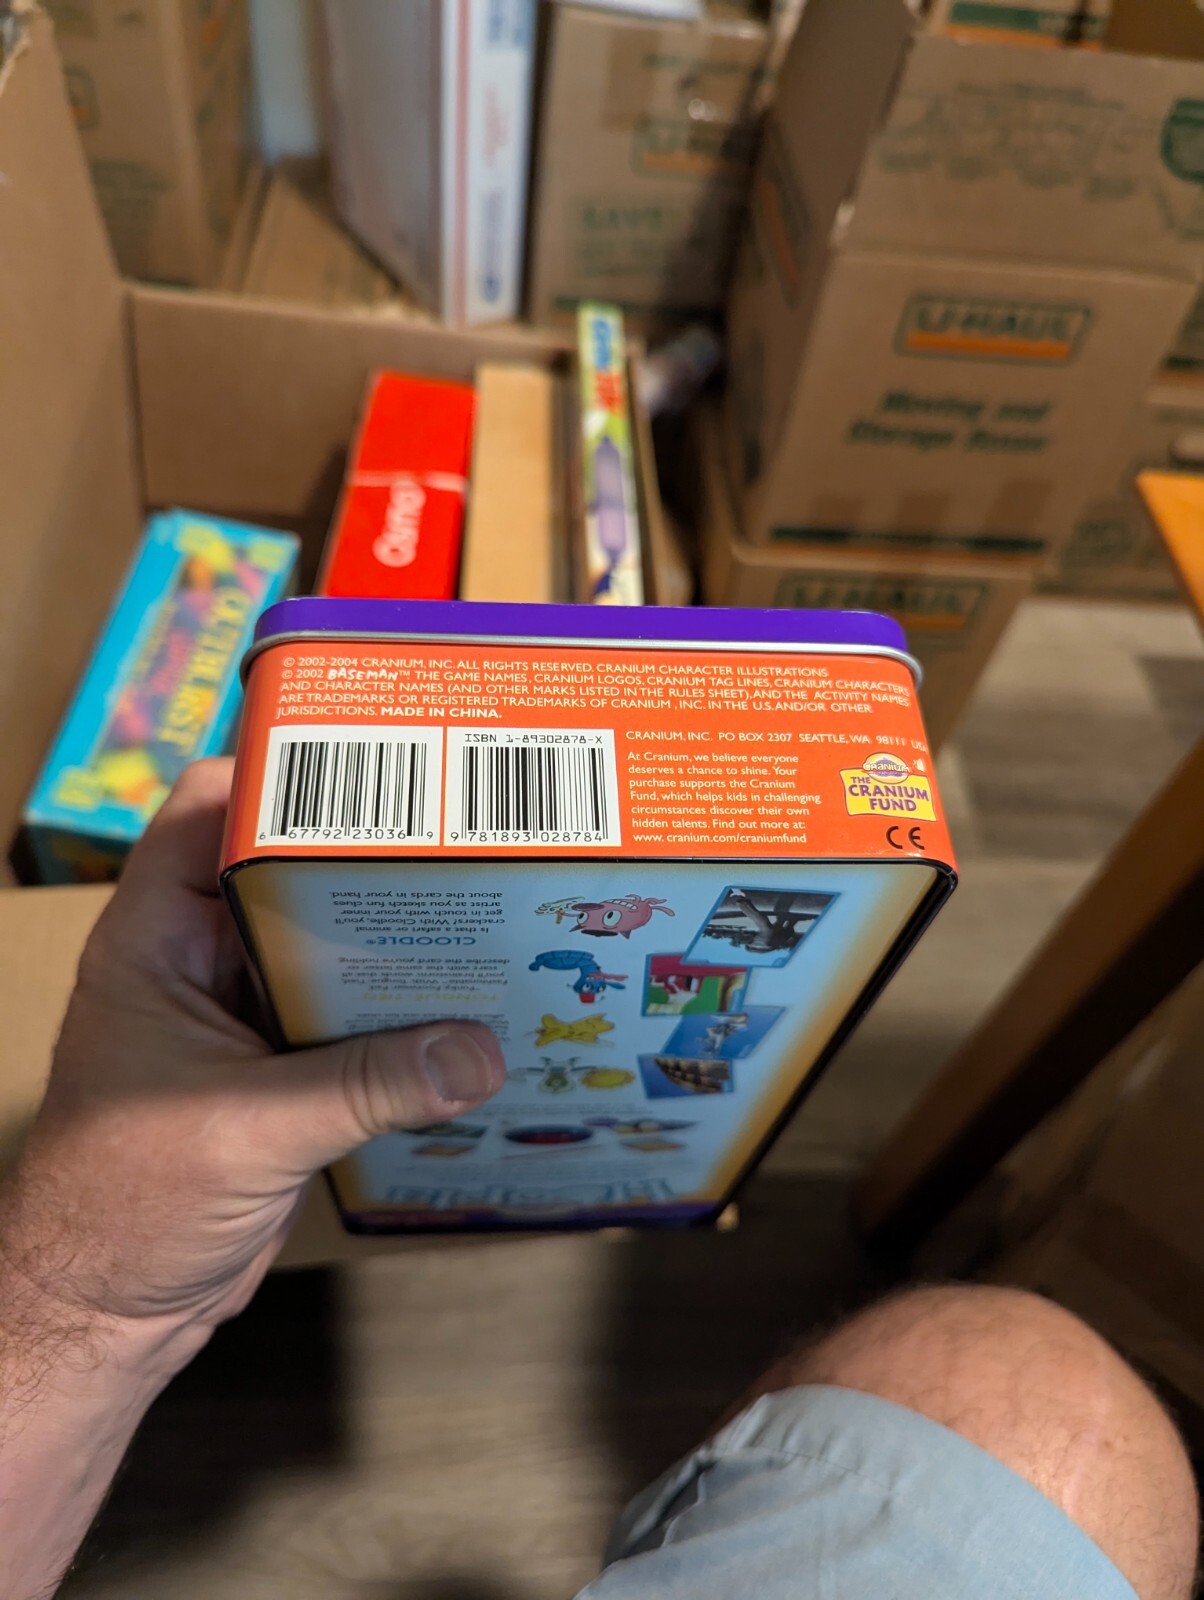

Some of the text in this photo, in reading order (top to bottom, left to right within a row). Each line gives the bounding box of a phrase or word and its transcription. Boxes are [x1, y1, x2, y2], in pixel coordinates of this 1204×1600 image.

[299, 658, 358, 667] 2002-2004
[429, 659, 455, 669] INC.
[457, 660, 479, 670] ALL
[483, 661, 528, 671] RIGHTS
[532, 662, 594, 673] RESERVED.
[596, 663, 655, 674] CRANIUM
[659, 665, 733, 676] CHARACTER
[737, 666, 828, 677] ILLUSTRATIONS
[296, 669, 324, 679] 2002
[414, 671, 440, 681] THE
[444, 672, 480, 682] GAME
[534, 674, 594, 684] CRANIUM
[598, 675, 644, 686] LOGOS,
[647, 676, 706, 686] CRANIUM
[709, 677, 734, 687] TAG
[737, 678, 772, 689] LINES,
[774, 678, 832, 689] CRANIUM
[835, 680, 910, 697] CHARACTERS
[280, 682, 311, 692] AND
[315, 682, 395, 692] CHARACTER
[400, 683, 444, 693] NAMES
[448, 684, 482, 695] (AND
[486, 684, 530, 695] OTHER
[534, 685, 576, 696] MARKS
[580, 686, 620, 696] LISTED
[624, 687, 637, 696] IN
[639, 688, 664, 697] THE
[668, 688, 705, 698] RULES
[782, 690, 808, 700] THE
[814, 691, 867, 702] ACTIVITY
[871, 693, 910, 707] NAMES
[278, 694, 304, 704] ARE
[306, 694, 394, 704] TRADEMARKS
[399, 694, 418, 704] OR
[422, 695, 499, 706] REGISTERED
[501, 696, 586, 708] TRADEMARKS
[590, 698, 607, 708] OF
[708, 700, 722, 710] IN
[724, 701, 748, 711] THE
[830, 703, 872, 713] OTHER
[276, 706, 502, 720] JURISDICTIONS. MADE IN CHINA.
[464, 734, 602, 744] ISBN 1-89302878-X
[626, 731, 686, 742] CRANIUM,
[688, 732, 713, 741] INC.
[718, 732, 735, 741] PO
[739, 732, 764, 742] BOX
[767, 733, 792, 742] 2307
[798, 733, 848, 744] SEATTLE,
[849, 734, 870, 744] WA
[876, 735, 905, 746] 98111
[628, 752, 640, 761] At
[644, 752, 692, 762] Cranium,
[712, 753, 747, 762] believe
[751, 756, 798, 765] everyone
[628, 765, 674, 774] deserves
[686, 766, 722, 774] chance
[726, 767, 738, 775] to
[740, 766, 770, 776] shine.
[772, 766, 797, 776] Your
[629, 778, 795, 790] purchase supports the Cranium
[850, 776, 871, 784] THE
[630, 791, 822, 804] Fund, which helps kids in challenging
[848, 784, 929, 802] CRANIUM
[631, 805, 810, 816] circumstances discover their own
[868, 798, 917, 812] FUND
[632, 818, 806, 829] hidden talents. Find out more at:
[259, 828, 434, 840] 6 67792 23036 9
[450, 831, 602, 842] 9 781893 028784
